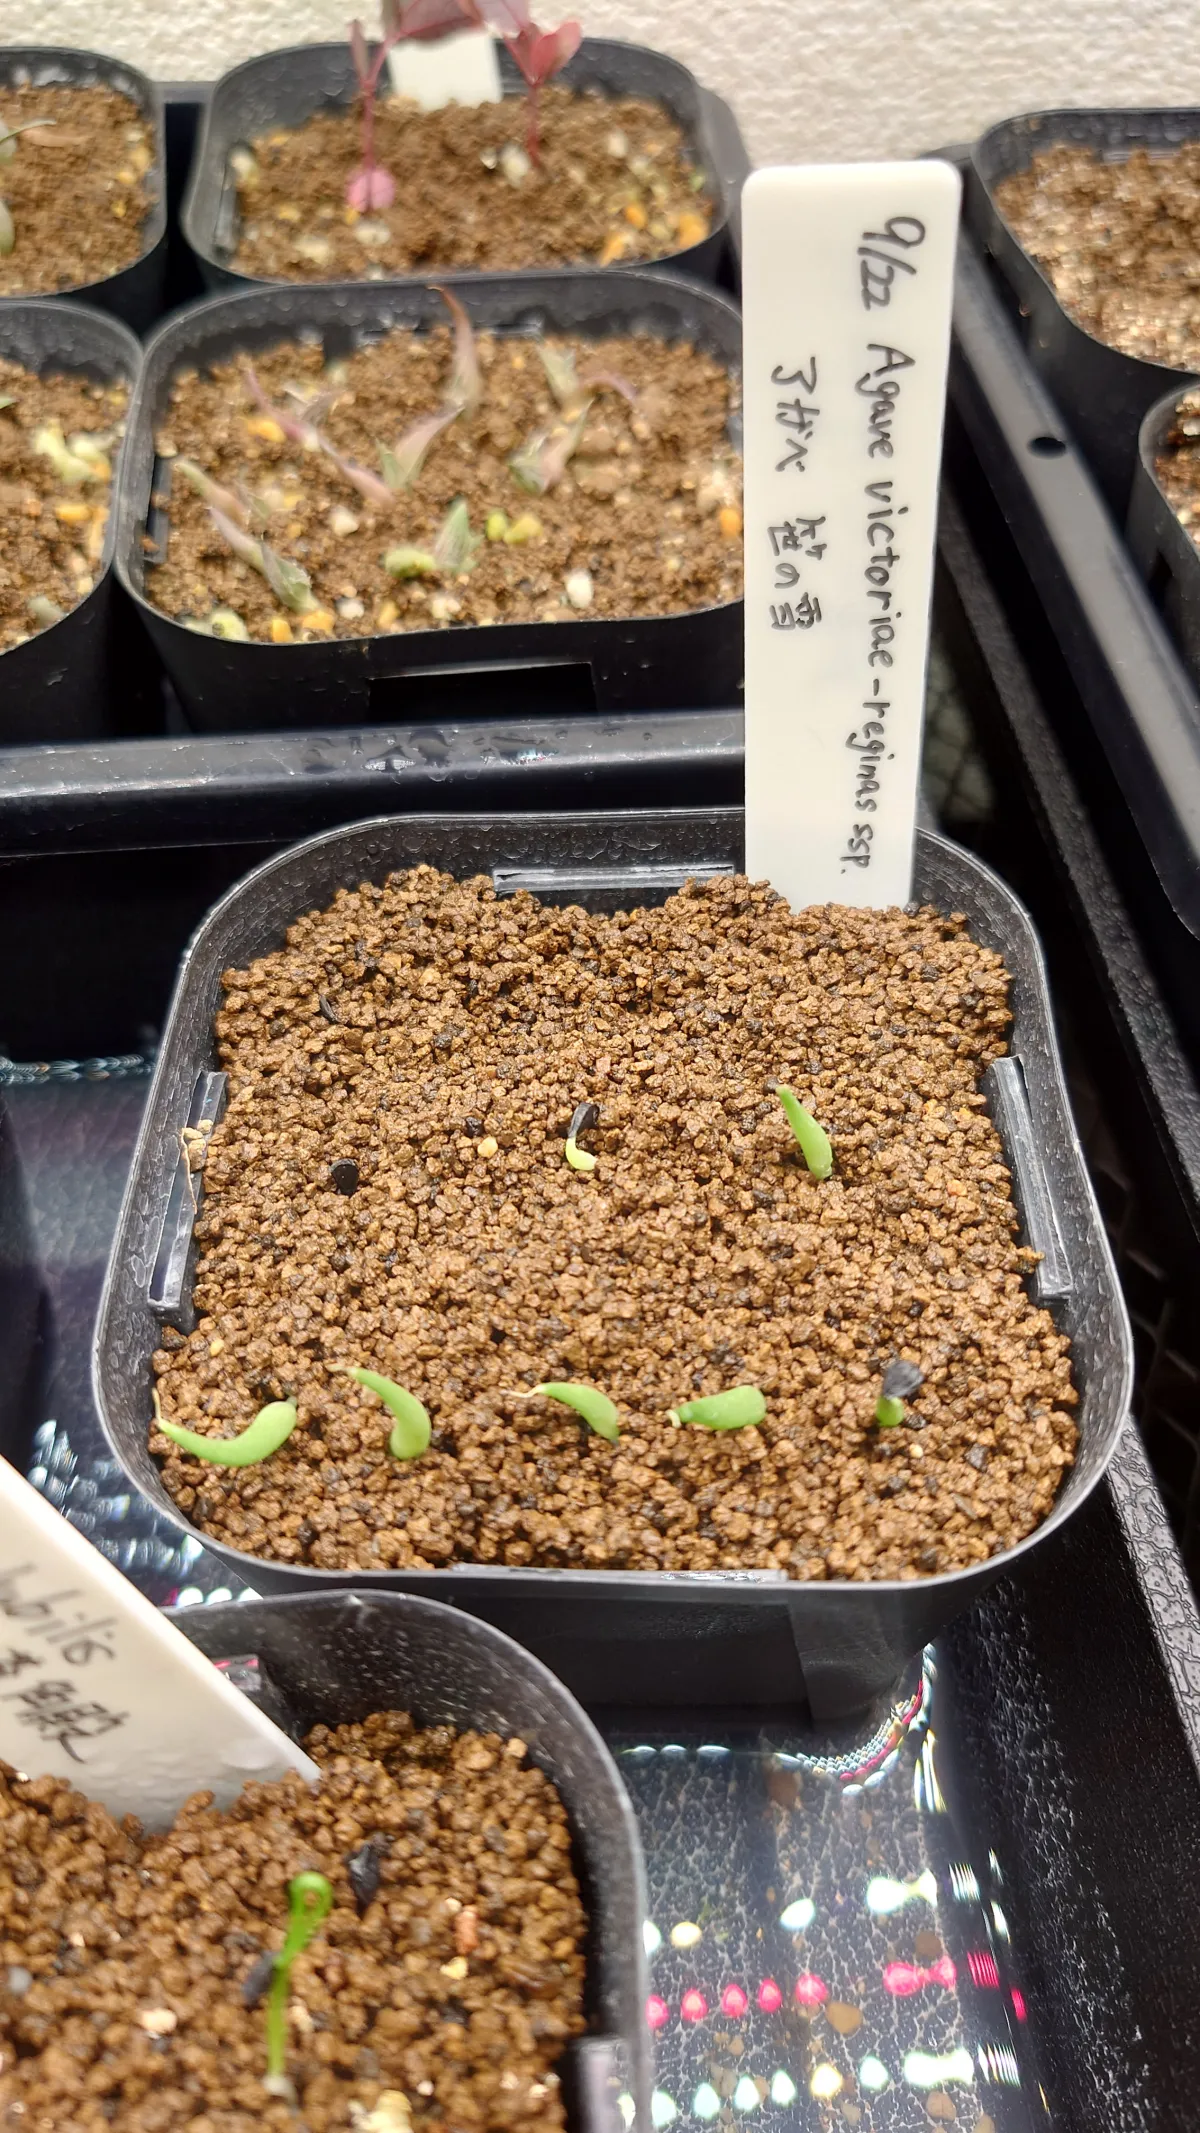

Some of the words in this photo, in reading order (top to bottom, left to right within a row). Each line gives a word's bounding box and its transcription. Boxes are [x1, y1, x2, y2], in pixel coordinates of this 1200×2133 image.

[856, 215, 927, 311] 9/22
[770, 356, 821, 473] アガベ
[854, 343, 916, 460] Agave
[767, 514, 828, 632] 笹の雪
[839, 822, 874, 875] ssp.
